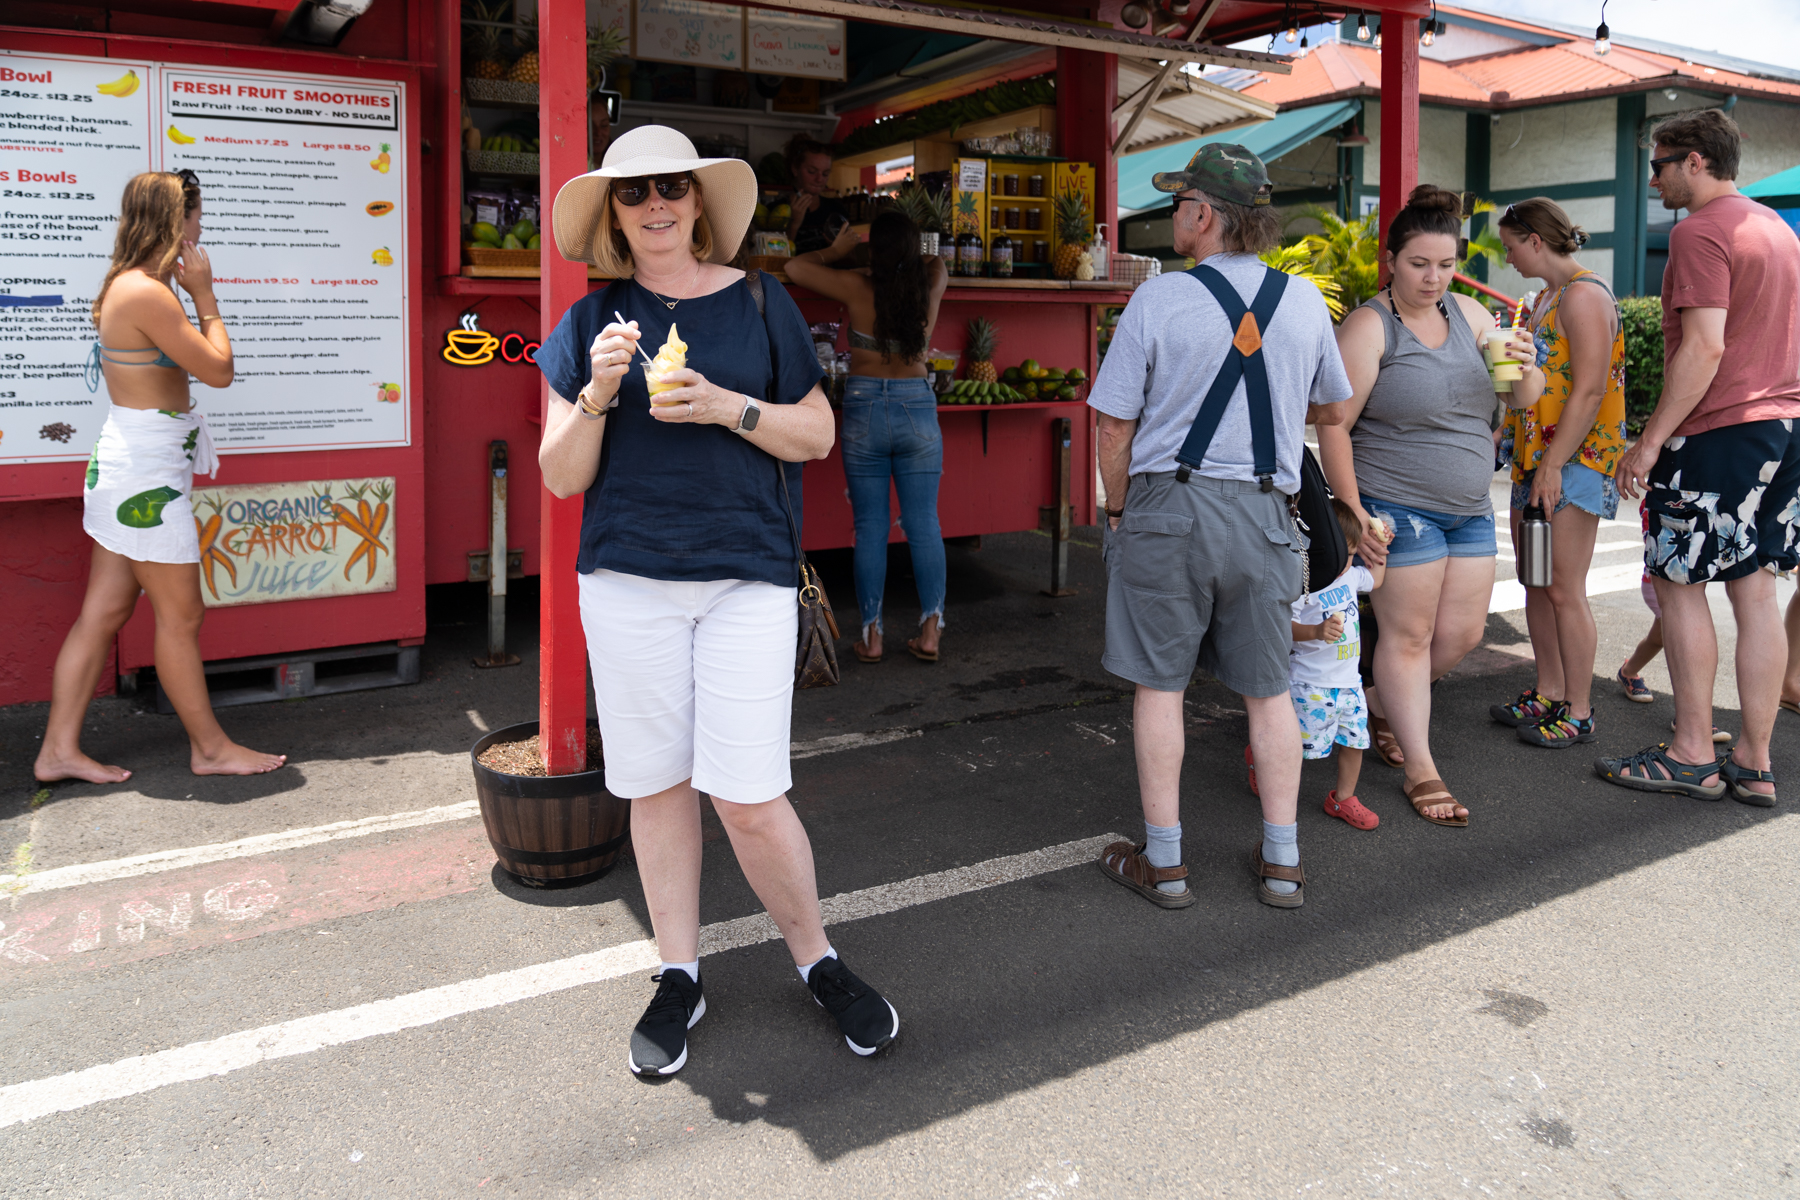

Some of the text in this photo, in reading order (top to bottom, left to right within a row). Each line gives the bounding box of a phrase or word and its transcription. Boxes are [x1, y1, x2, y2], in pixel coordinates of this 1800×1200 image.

[0, 67, 52, 83] Bowl
[46, 93, 93, 103] $13.25
[172, 80, 391, 108] FRESH FRUIT SMOOTHIES
[172, 100, 200, 108] Raw
[201, 102, 232, 111] Fruit
[265, 106, 284, 114] NO
[285, 107, 323, 117] DAIRY
[332, 111, 350, 119] NO
[352, 112, 392, 122] SUGAR
[0, 112, 69, 122] awberries,
[8, 121, 62, 132] blended
[0, 145, 64, 153] UBSTITUTES
[204, 136, 371, 152] Medium $7.25 Large $8.50
[17, 169, 78, 184] Bowls
[192, 168, 234, 176] rawberry,
[1059, 175, 1088, 190] LIVE
[49, 191, 96, 201] $13.25
[308, 199, 347, 207] pineapple
[4, 211, 39, 219] from
[67, 214, 121, 222] smooth
[264, 212, 295, 220] papaya
[26, 222, 41, 230] of
[43, 222, 64, 230] the
[1, 232, 41, 240] $1.50
[264, 277, 299, 285] $9.50
[311, 278, 343, 287] Large
[501, 333, 541, 363] Co
[226, 494, 333, 524] ORGANIC
[221, 520, 345, 565] CARROT
[223, 559, 339, 597] Juice
